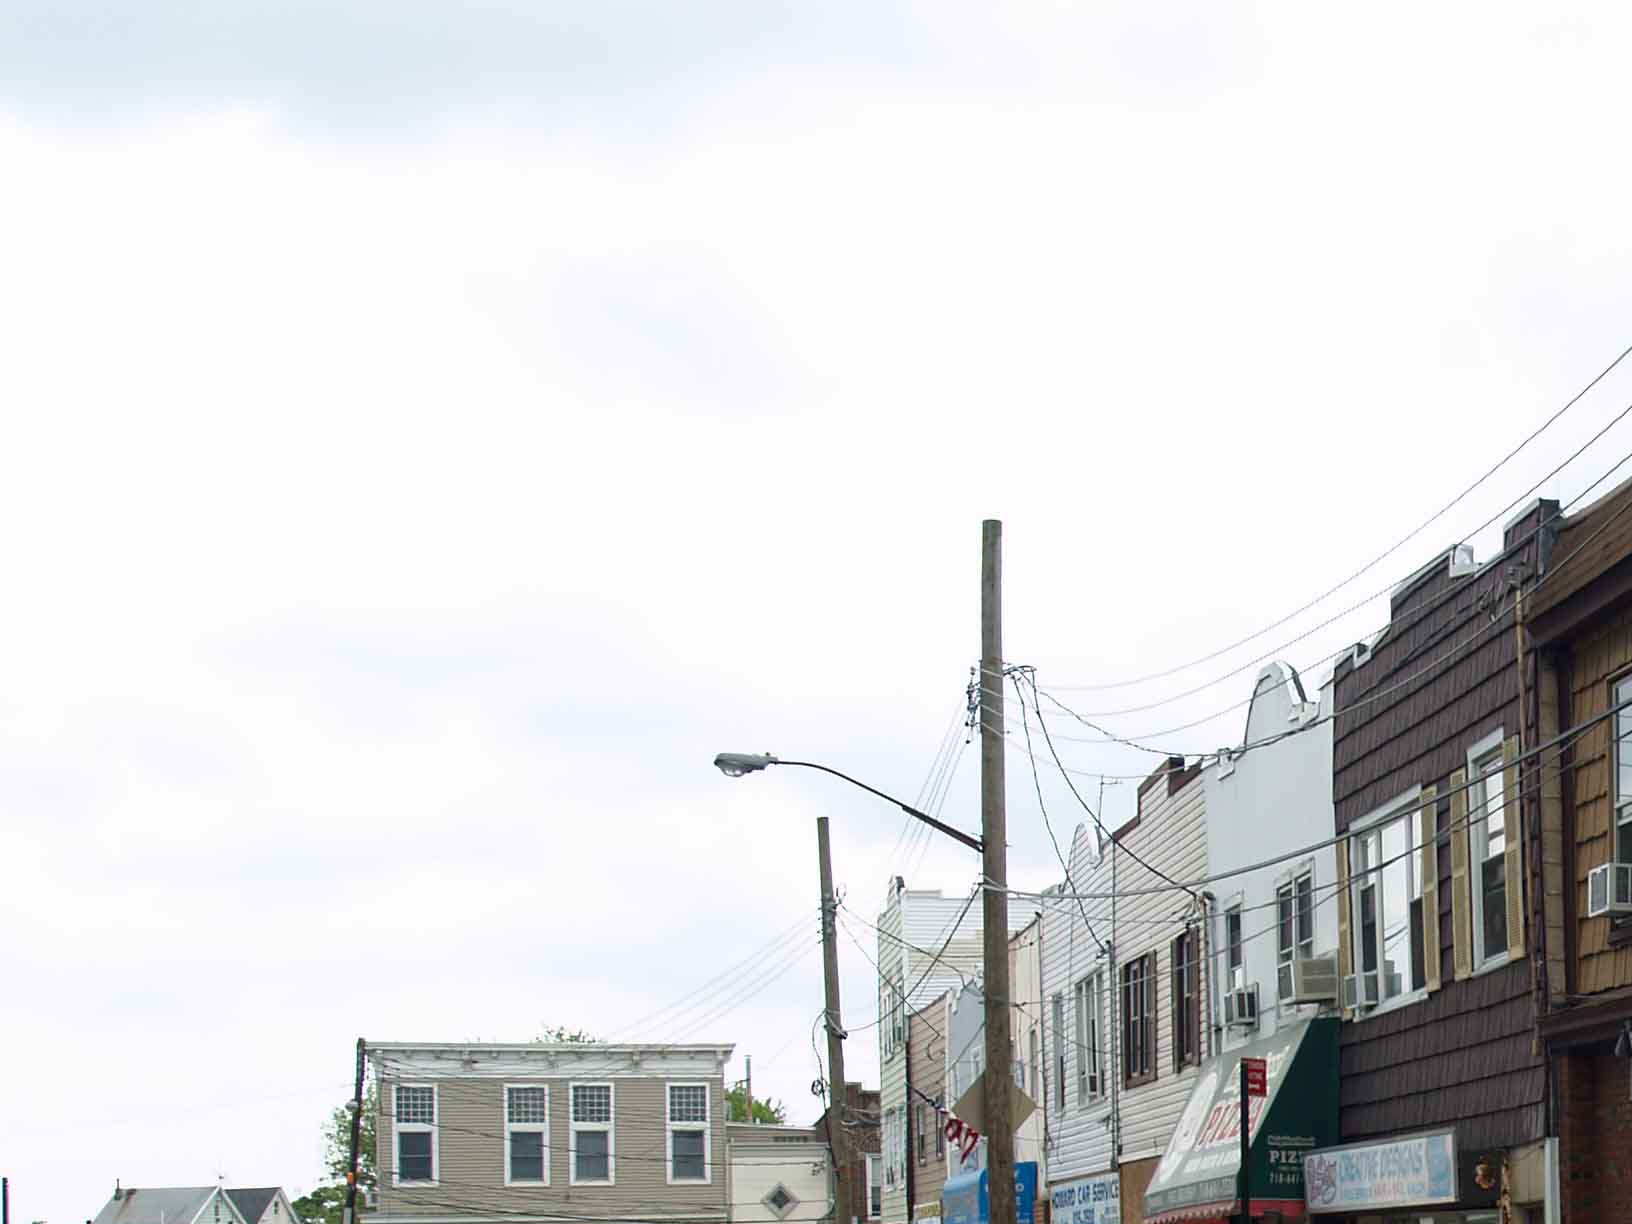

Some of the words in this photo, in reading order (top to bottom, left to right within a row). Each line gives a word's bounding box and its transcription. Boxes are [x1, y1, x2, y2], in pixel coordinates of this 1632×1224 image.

[1269, 1151, 1305, 1164] PIZZ
[1078, 1184, 1090, 1205] CAR
[1093, 1179, 1119, 1202] SERVICE
